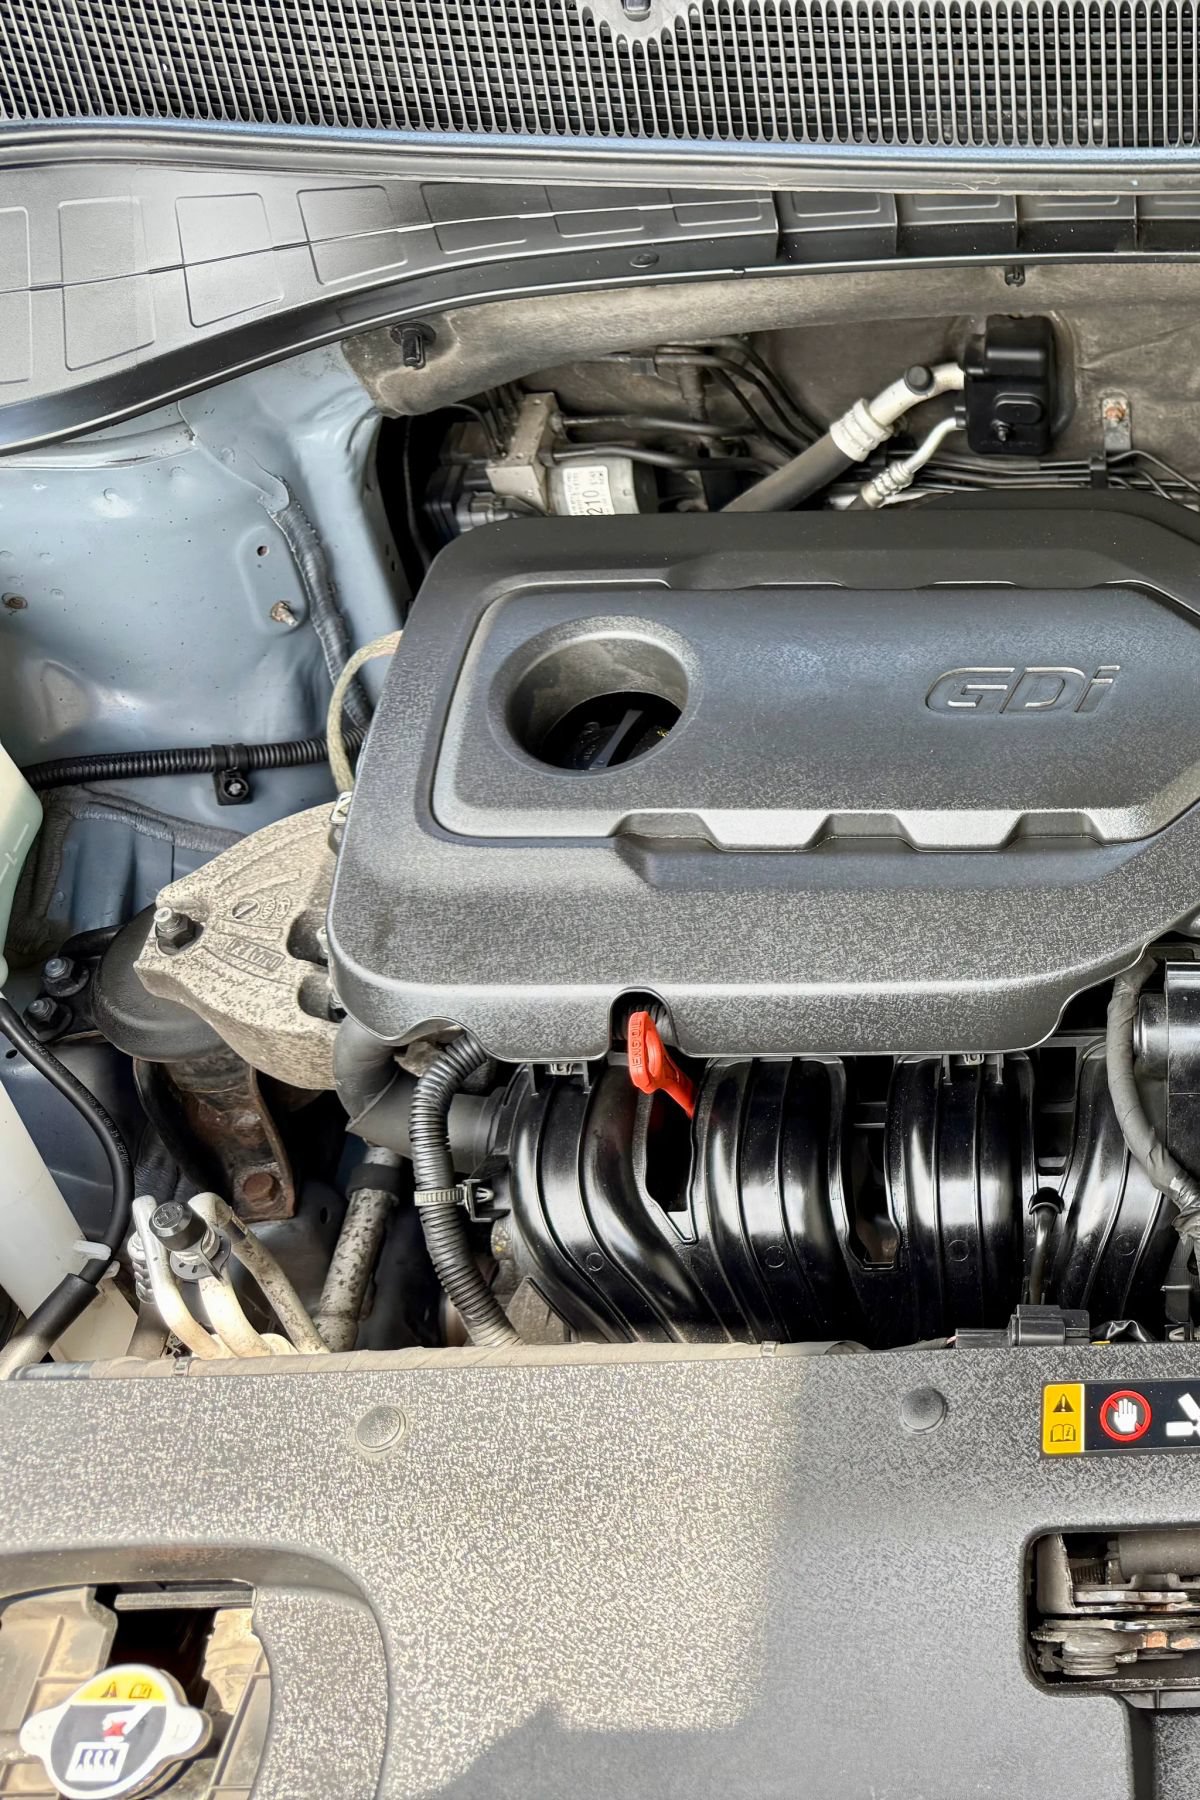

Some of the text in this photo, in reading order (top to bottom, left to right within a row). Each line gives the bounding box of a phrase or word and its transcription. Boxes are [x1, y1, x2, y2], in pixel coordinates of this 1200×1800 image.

[924, 664, 1121, 715] GDi
[631, 1020, 643, 1068] ENG OIL
